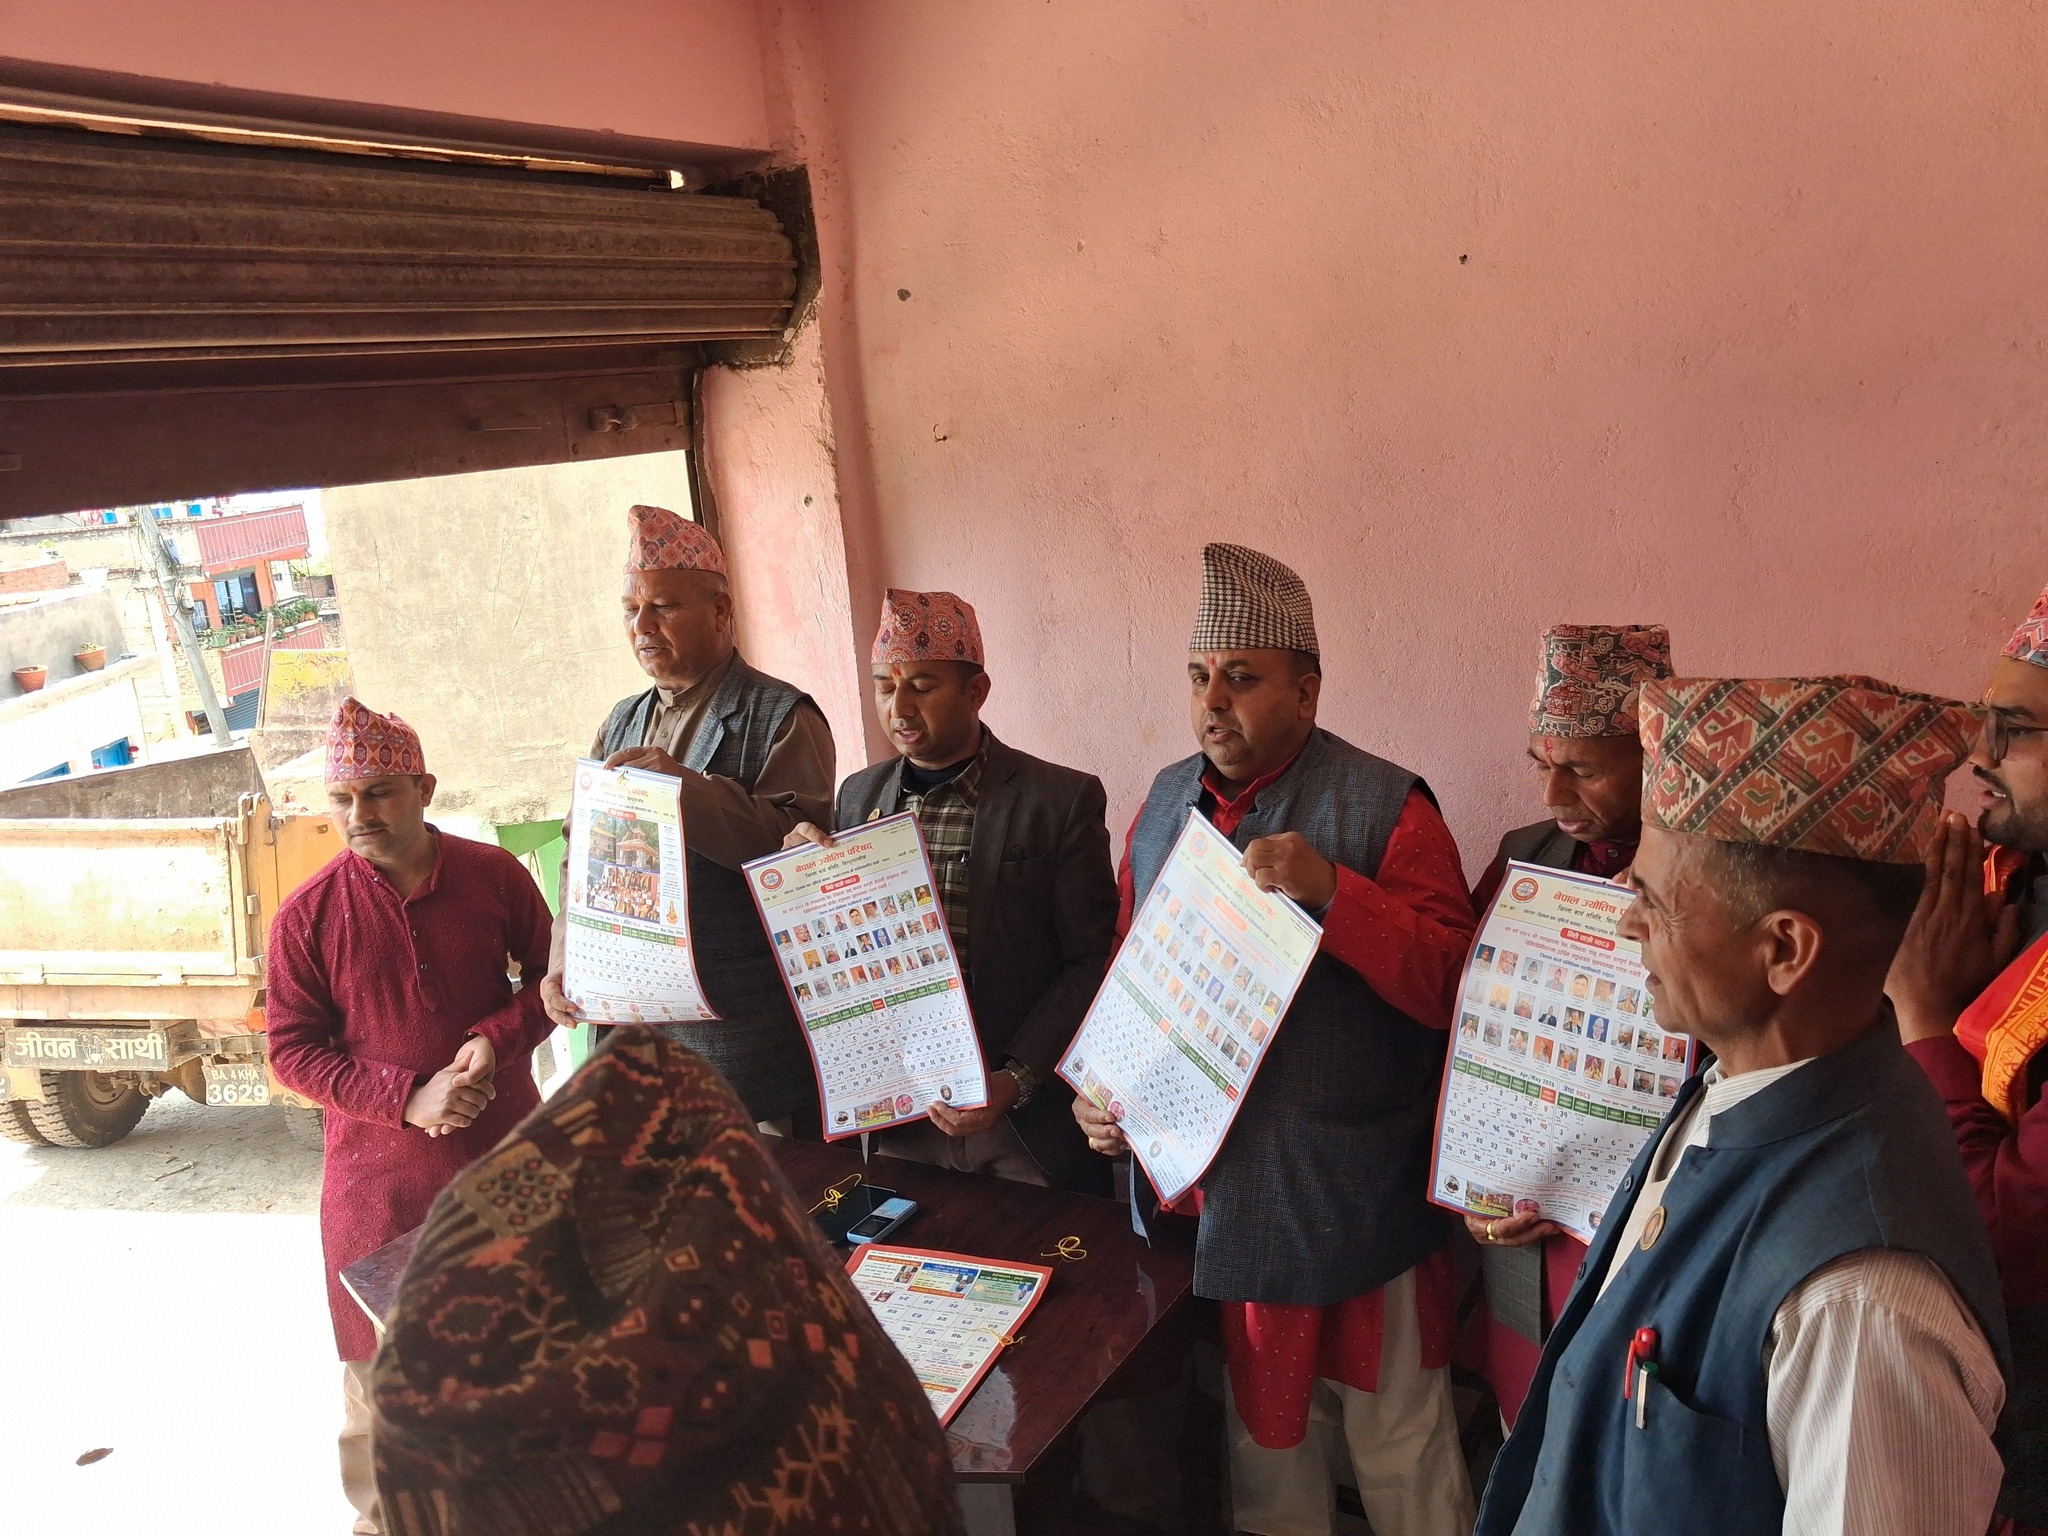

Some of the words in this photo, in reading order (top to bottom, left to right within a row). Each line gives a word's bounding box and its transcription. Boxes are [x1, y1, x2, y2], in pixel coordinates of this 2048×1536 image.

[794, 860, 816, 872] नेपाल
[817, 850, 844, 864] ज्योतिष
[1553, 890, 1580, 904] नेपाल
[1582, 896, 1616, 913] ज्योतिष
[14, 1031, 78, 1059] जीवन
[105, 1030, 163, 1061] साथी
[230, 1069, 236, 1079] 4
[237, 1067, 259, 1080] KHA
[1519, 1071, 1541, 1082] Apr/May
[208, 1082, 268, 1104] 3629
